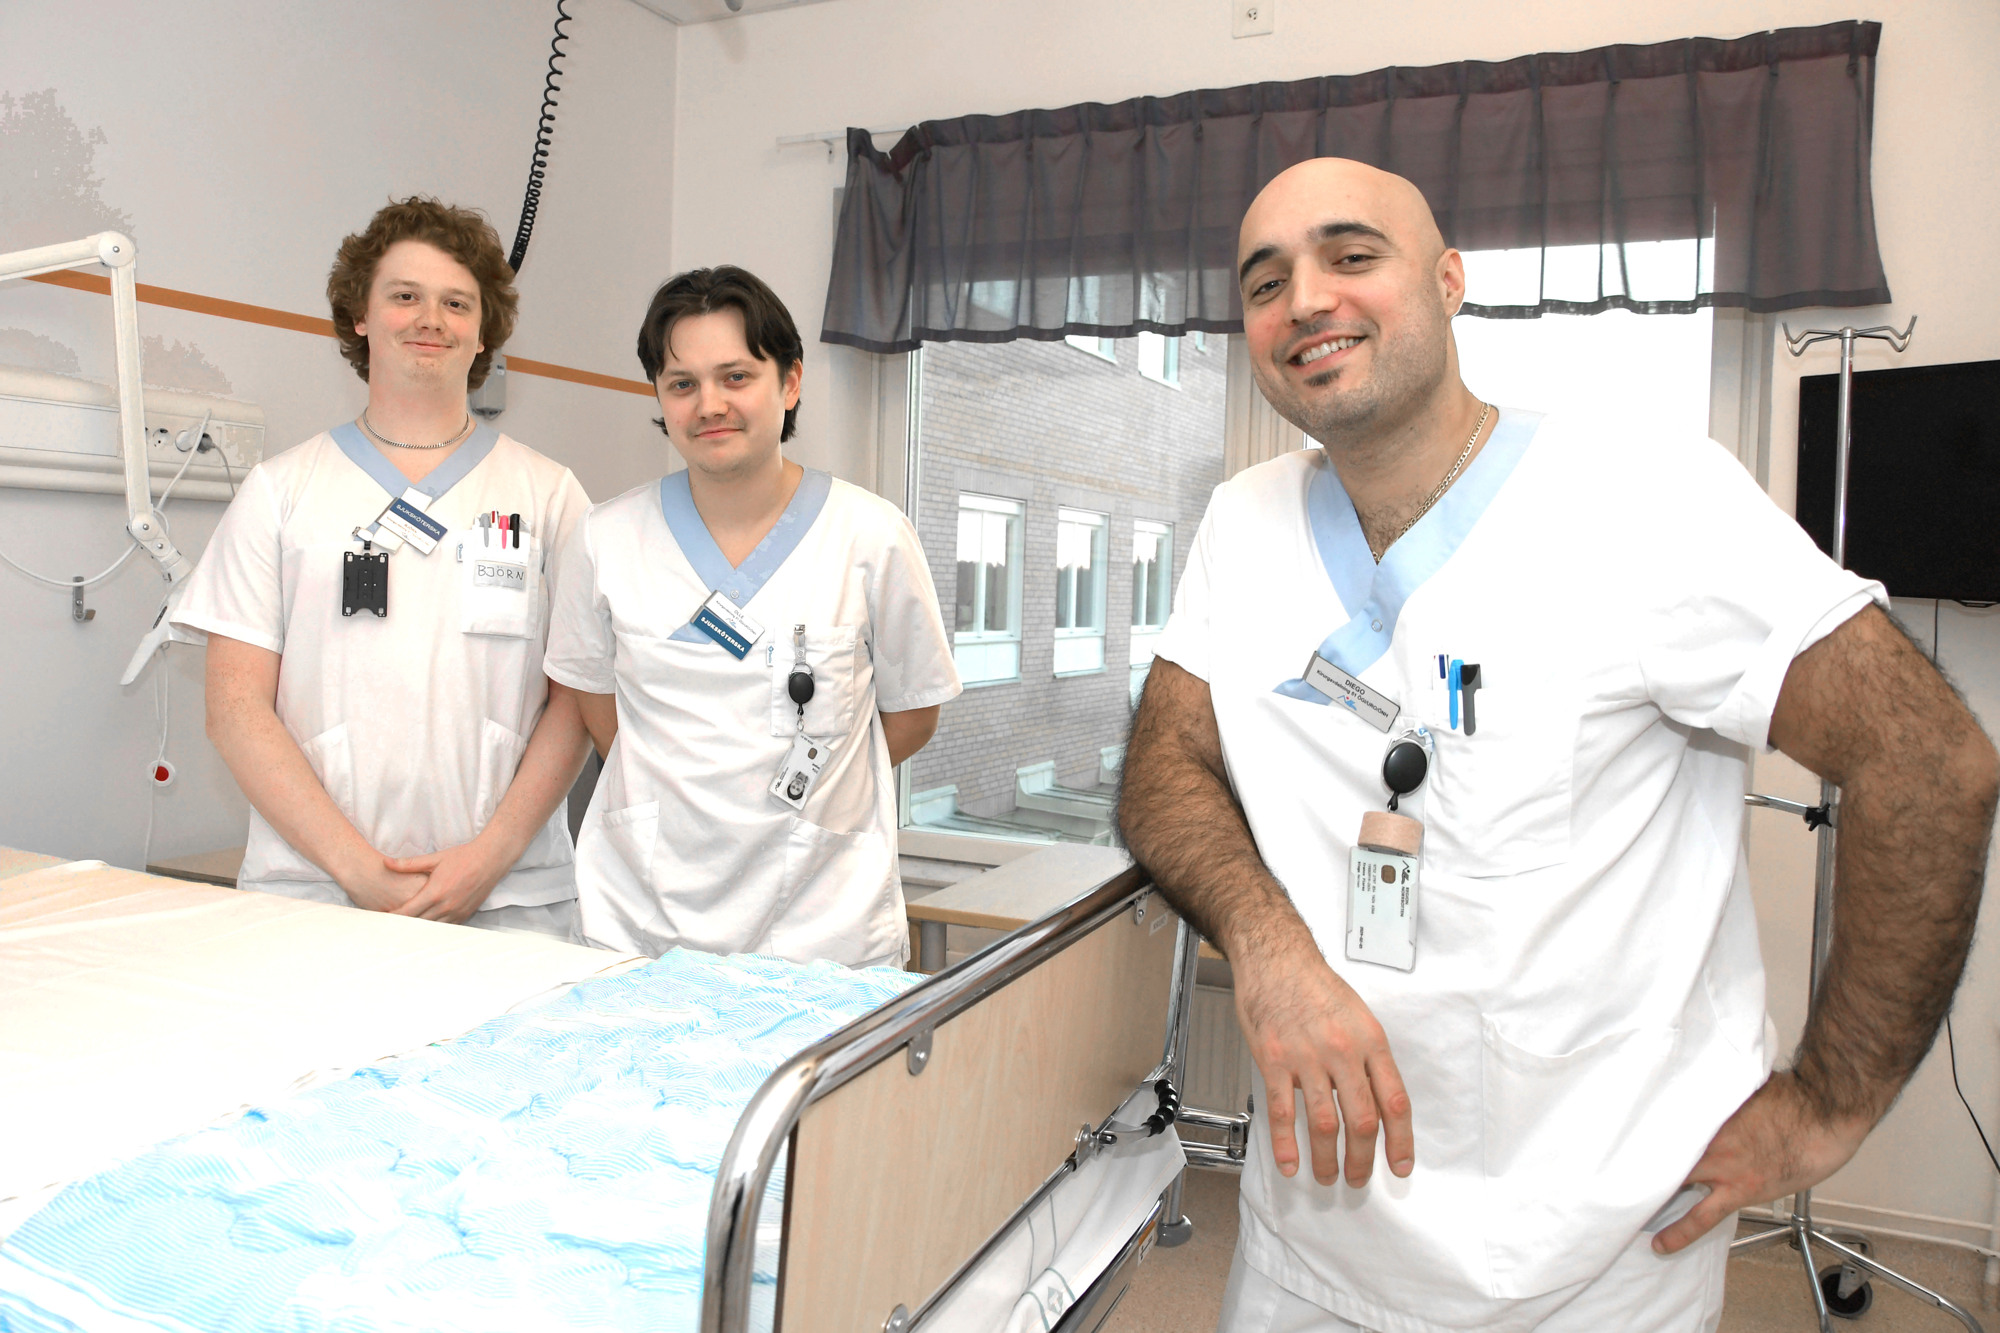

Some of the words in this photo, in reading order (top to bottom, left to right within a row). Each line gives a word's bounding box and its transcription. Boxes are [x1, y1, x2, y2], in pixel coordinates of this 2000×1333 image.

[396, 504, 440, 535] SJUKSKÖTERSKA
[477, 564, 524, 580] BJÖRN
[701, 616, 745, 653] SJUKSKÖTERSKA
[1345, 679, 1366, 695] DIEGO
